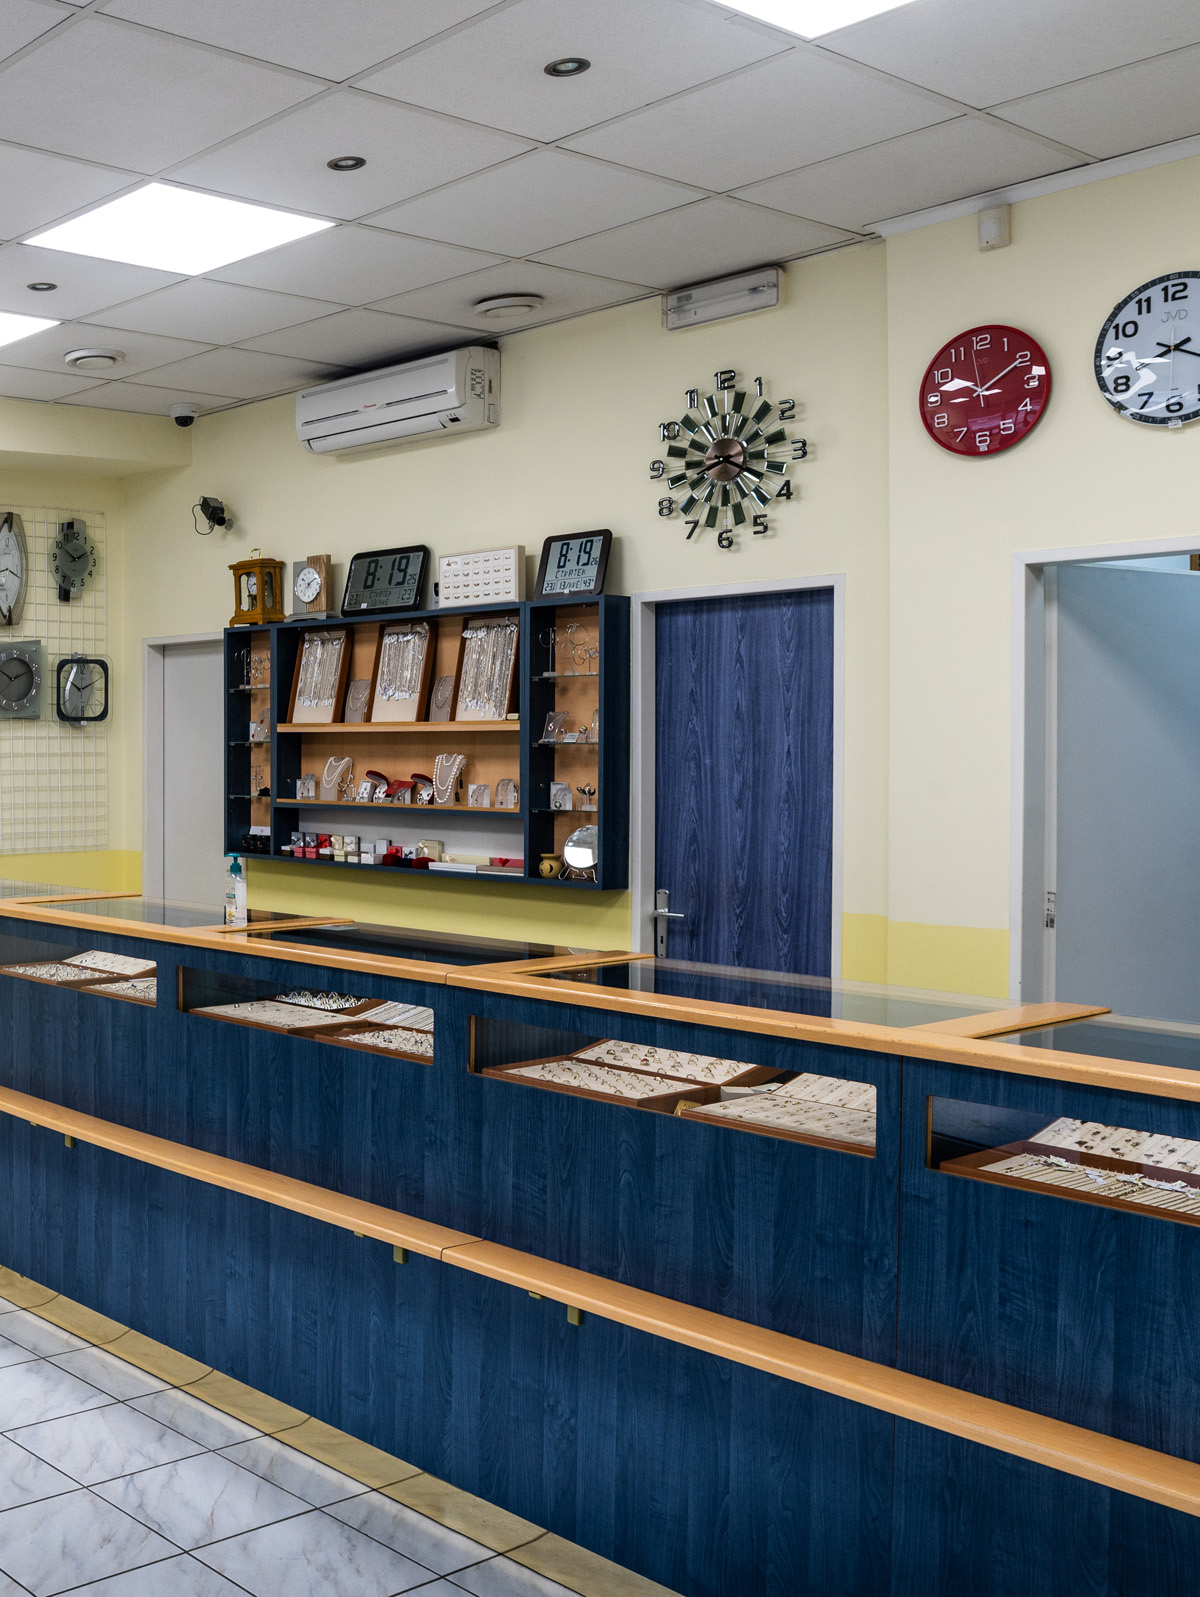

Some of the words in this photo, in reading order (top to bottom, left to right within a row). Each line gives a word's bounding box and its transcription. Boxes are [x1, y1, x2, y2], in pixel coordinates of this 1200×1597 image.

[1161, 281, 1188, 303] 12
[1135, 296, 1152, 316] 11
[1161, 309, 1188, 323] JVD
[1112, 320, 1139, 341] 10
[972, 334, 991, 350] 12
[1003, 337, 1008, 352] 1
[951, 347, 964, 362] 11
[976, 357, 989, 365] JVD
[1016, 351, 1031, 367] 2
[714, 369, 736, 391] 12
[934, 368, 951, 384] 10
[1024, 374, 1039, 389] 3
[754, 376, 763, 397] 1
[1113, 375, 1131, 394] 8
[685, 388, 699, 409] 11
[927, 392, 941, 407] 9
[1018, 397, 1033, 412] 4
[1137, 391, 1154, 410] 7
[1165, 394, 1184, 414] 6
[778, 399, 796, 421] 2
[934, 413, 948, 428] 8
[1000, 419, 1015, 435] 5
[658, 421, 680, 442] 10
[953, 427, 968, 442] 7
[976, 431, 990, 446] 6
[791, 438, 808, 460] 3
[649, 460, 665, 480] 9
[775, 479, 793, 500] 4
[658, 497, 674, 517] 8
[684, 519, 700, 540] 7
[753, 513, 769, 535] 5
[63, 533, 69, 541] 11
[73, 532, 80, 540] 12
[717, 529, 734, 549] 6
[55, 541, 63, 550] 10
[90, 546, 94, 555] 2
[52, 553, 57, 561] 9
[557, 539, 594, 569] 8:19
[55, 565, 59, 574] 8
[92, 559, 97, 568] 3
[62, 575, 67, 584] 7
[88, 570, 93, 578] 4
[363, 555, 411, 590] 8:19
[406, 574, 417, 585] 25
[71, 580, 76, 588] 6
[80, 578, 85, 587] 5
